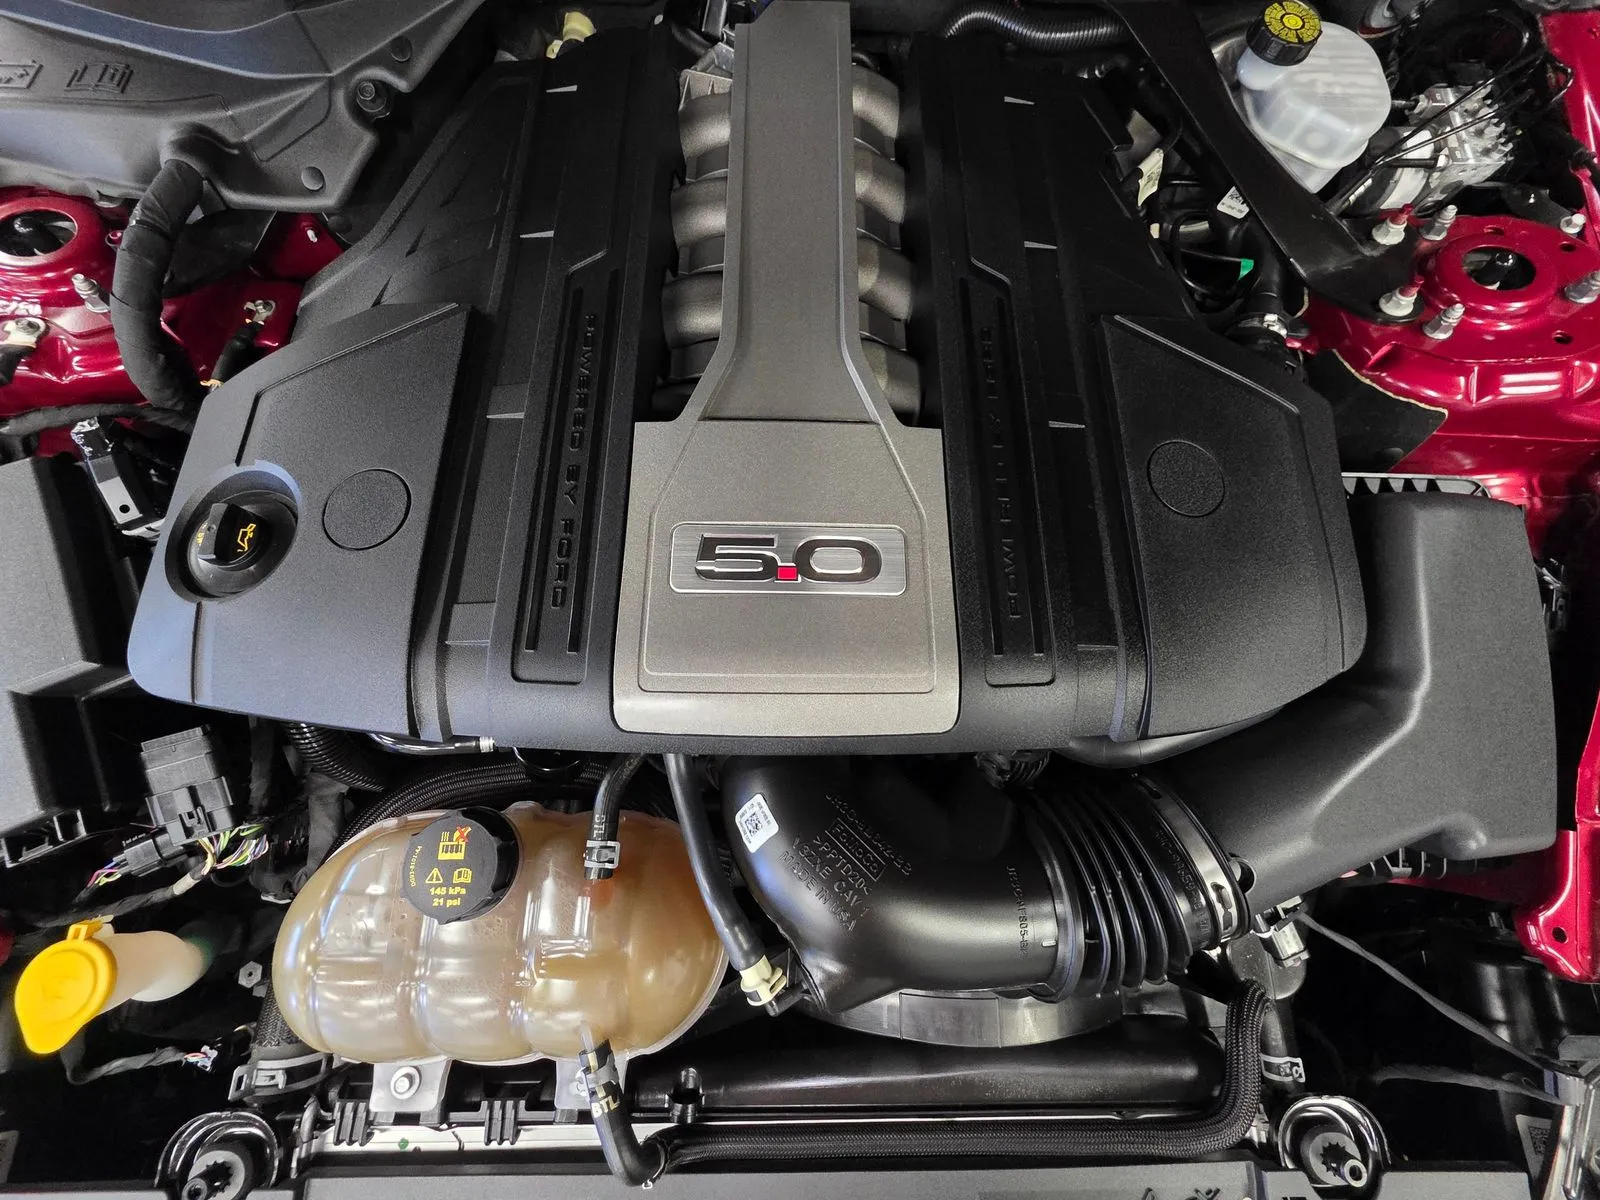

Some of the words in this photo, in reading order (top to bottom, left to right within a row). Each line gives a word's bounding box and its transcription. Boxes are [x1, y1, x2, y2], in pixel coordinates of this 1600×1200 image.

[569, 314, 597, 451] POWERED
[564, 464, 581, 505] BY
[551, 518, 575, 610] FORD
[695, 533, 882, 584] 5.0
[429, 887, 446, 895] 145
[448, 887, 466, 895] kPa
[432, 898, 444, 906] 21
[446, 897, 460, 908] psi
[777, 851, 818, 891] MADE
[815, 886, 833, 905] IN
[830, 902, 857, 931] USA
[832, 878, 861, 907] CAV
[591, 1096, 620, 1118] BTL
